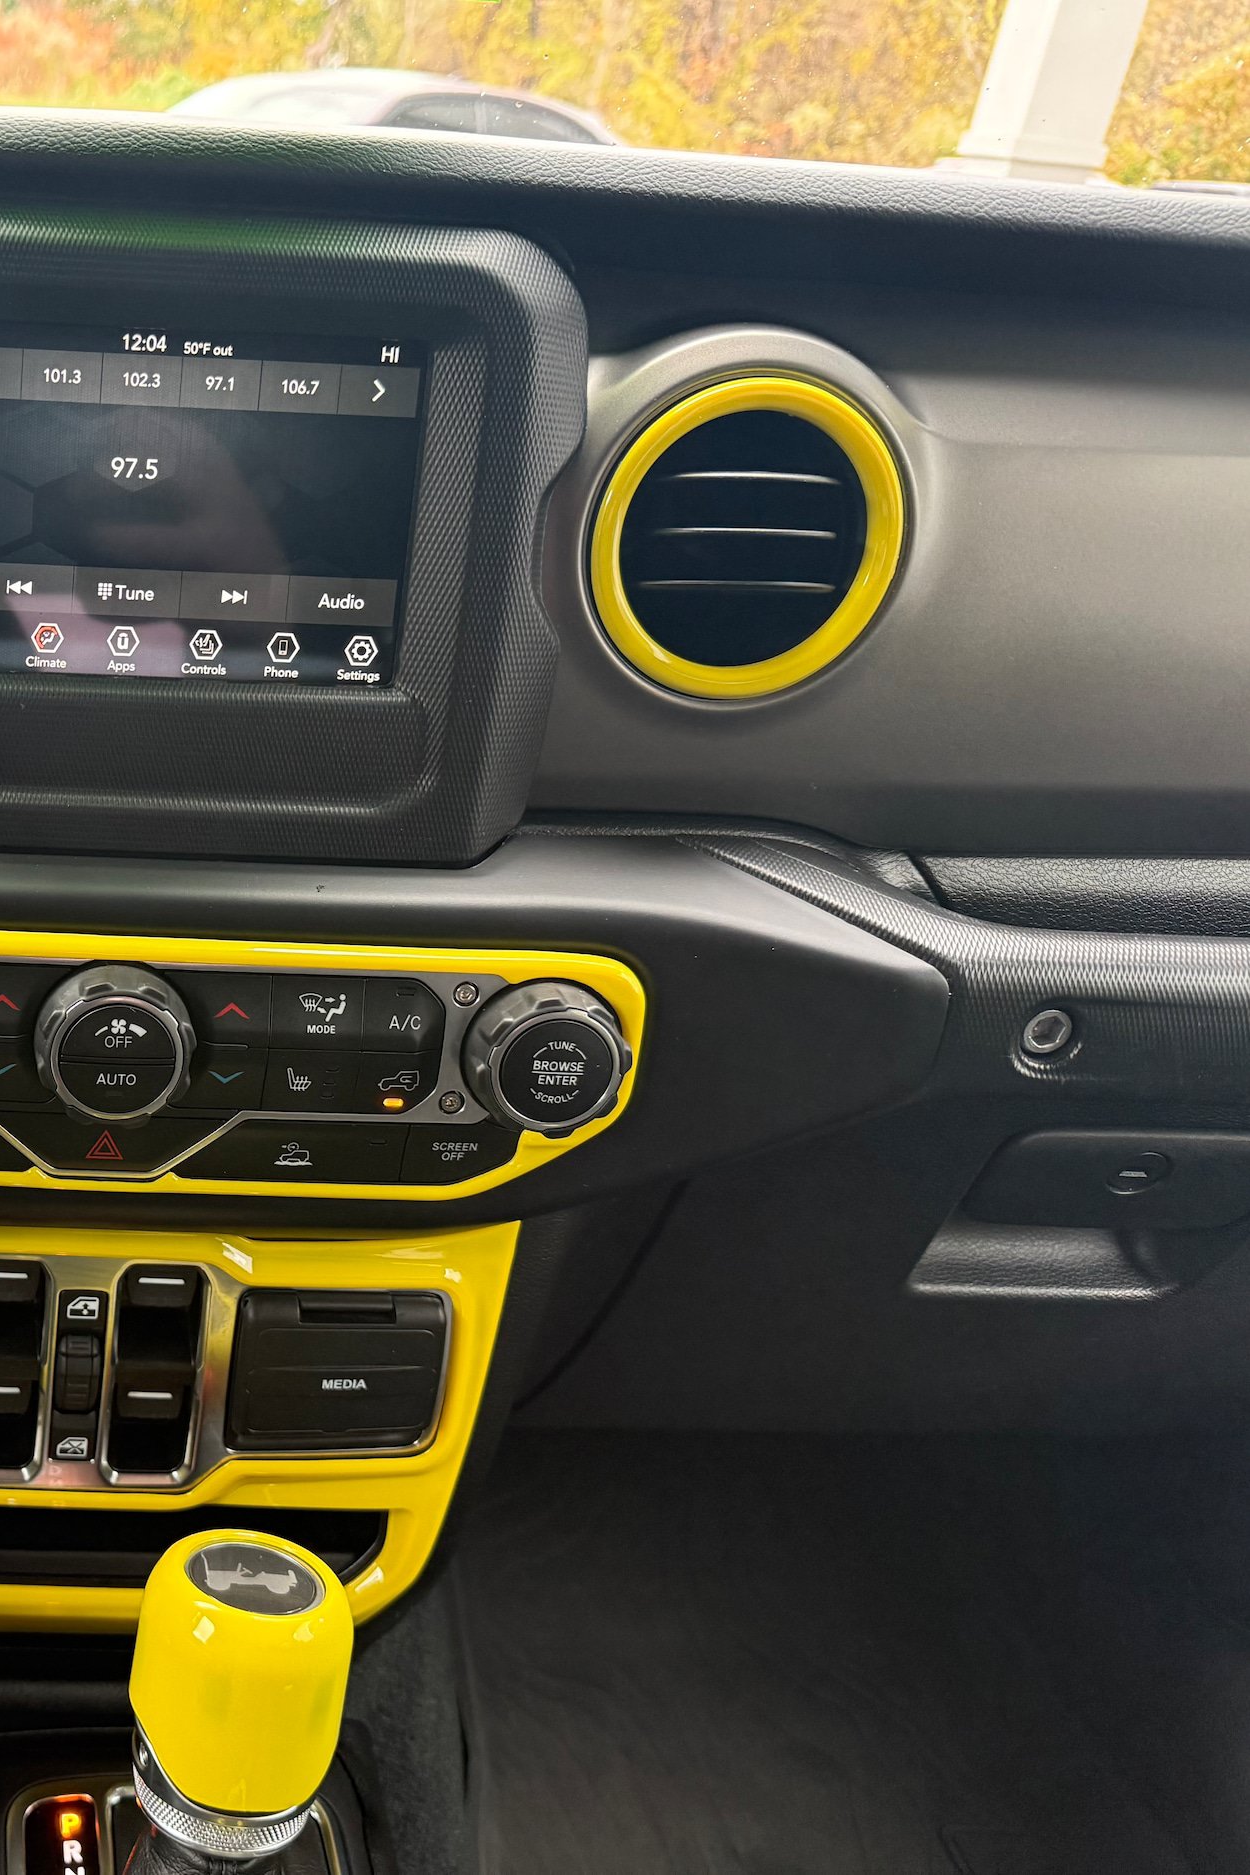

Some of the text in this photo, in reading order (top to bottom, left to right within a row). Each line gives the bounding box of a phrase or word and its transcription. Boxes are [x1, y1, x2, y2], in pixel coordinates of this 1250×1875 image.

[122, 333, 167, 352] 12:04
[213, 344, 233, 356] out
[381, 346, 400, 363] HI
[43, 368, 82, 384] 101.3
[122, 371, 161, 388] 102.3
[205, 376, 235, 391] 97.1
[281, 379, 320, 395] 106.7
[110, 456, 158, 480] 97.5
[115, 584, 155, 601] Tune
[317, 593, 365, 610] Audio
[25, 656, 67, 669] Climate
[107, 660, 136, 674] Apps
[181, 663, 227, 676] Controls
[263, 666, 299, 679] Phone
[336, 668, 381, 683] Settings
[306, 1024, 336, 1035] MODE
[388, 1016, 422, 1031] A/C
[104, 1035, 133, 1049] OFF
[547, 1041, 577, 1053] TUNE
[532, 1060, 584, 1073] BROWSE
[95, 1073, 137, 1086] AUTO
[537, 1075, 578, 1087] ENTER
[534, 1093, 575, 1104] SCROLL
[432, 1142, 479, 1152] SCREEN
[441, 1152, 465, 1162] OFF
[321, 1378, 367, 1391] MEDIA
[61, 1813, 80, 1838] P
[63, 1840, 83, 1864] R
